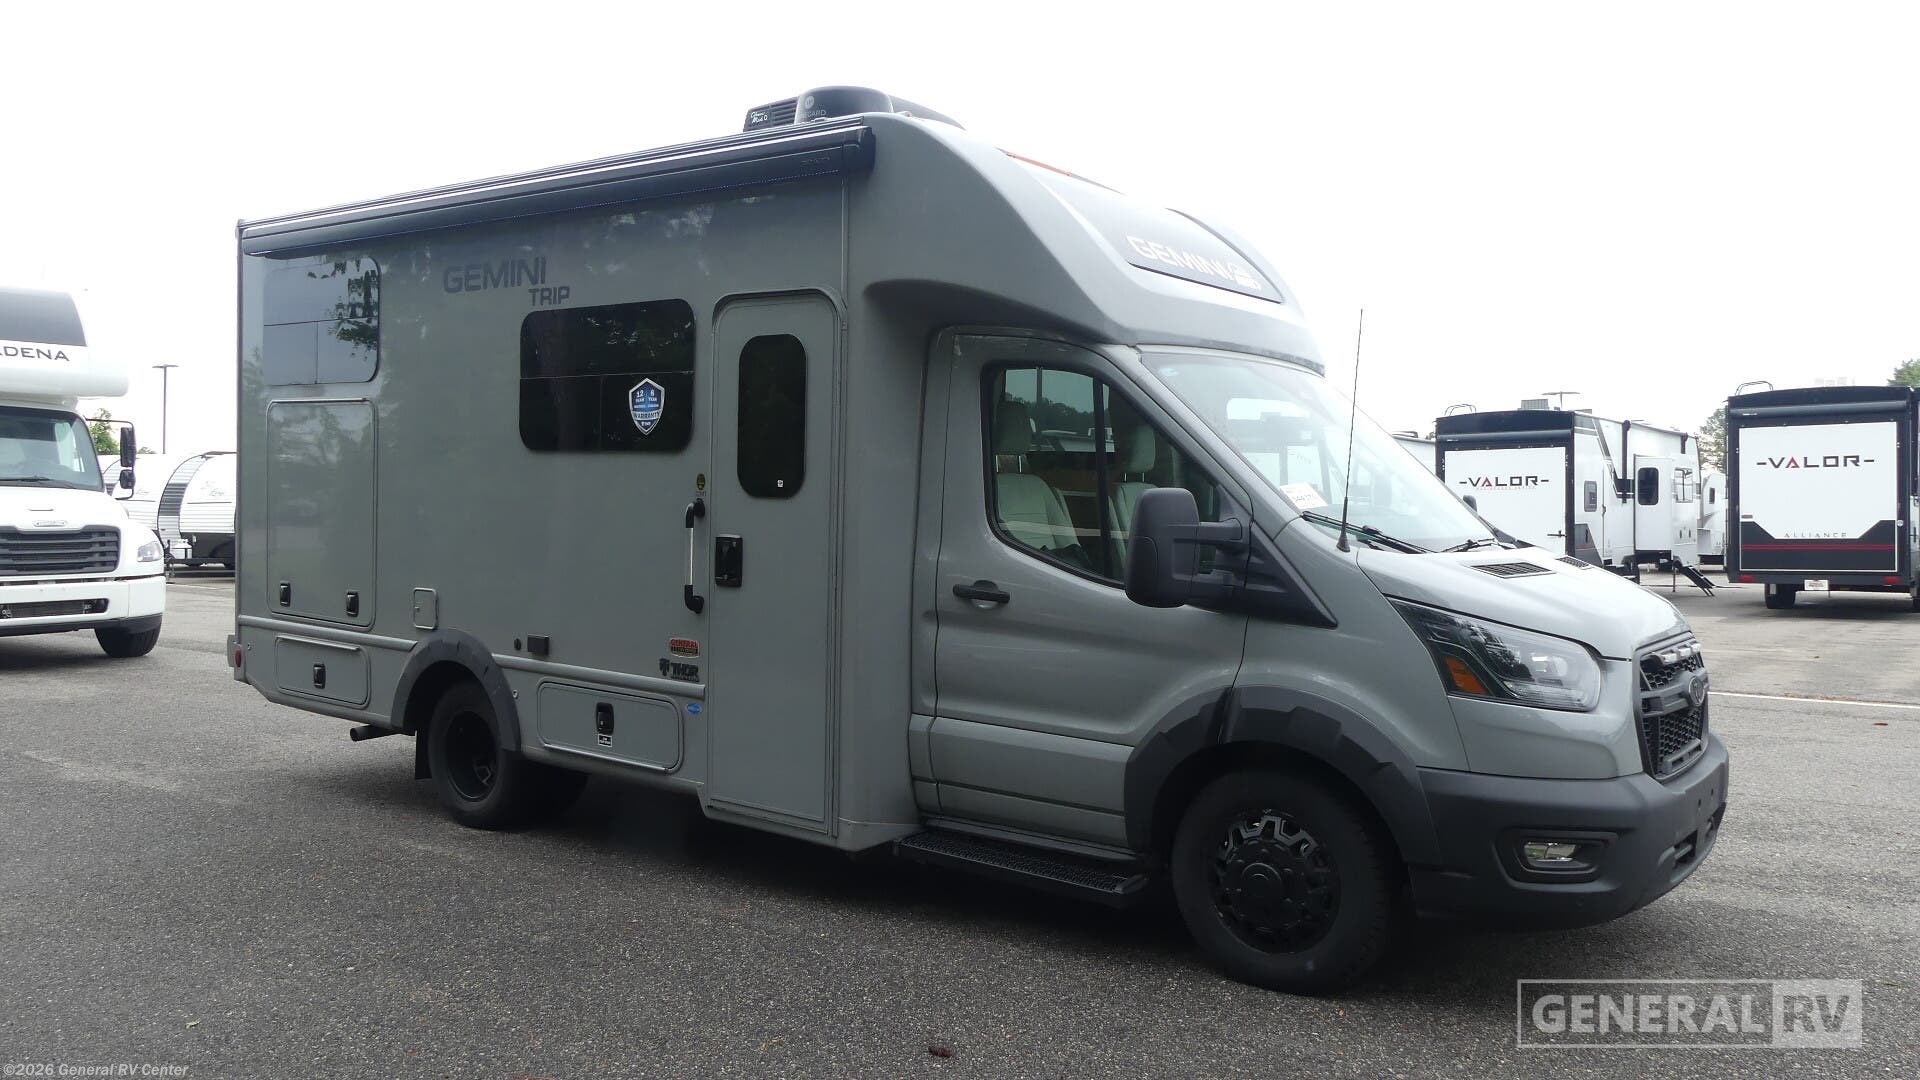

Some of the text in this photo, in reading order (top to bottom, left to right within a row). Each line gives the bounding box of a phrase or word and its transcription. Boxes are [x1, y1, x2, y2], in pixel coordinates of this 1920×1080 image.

[1126, 235, 1234, 281] GEMINI
[443, 255, 547, 294] GEMINI
[528, 286, 570, 307] TRIP
[0, 346, 70, 361] DENA
